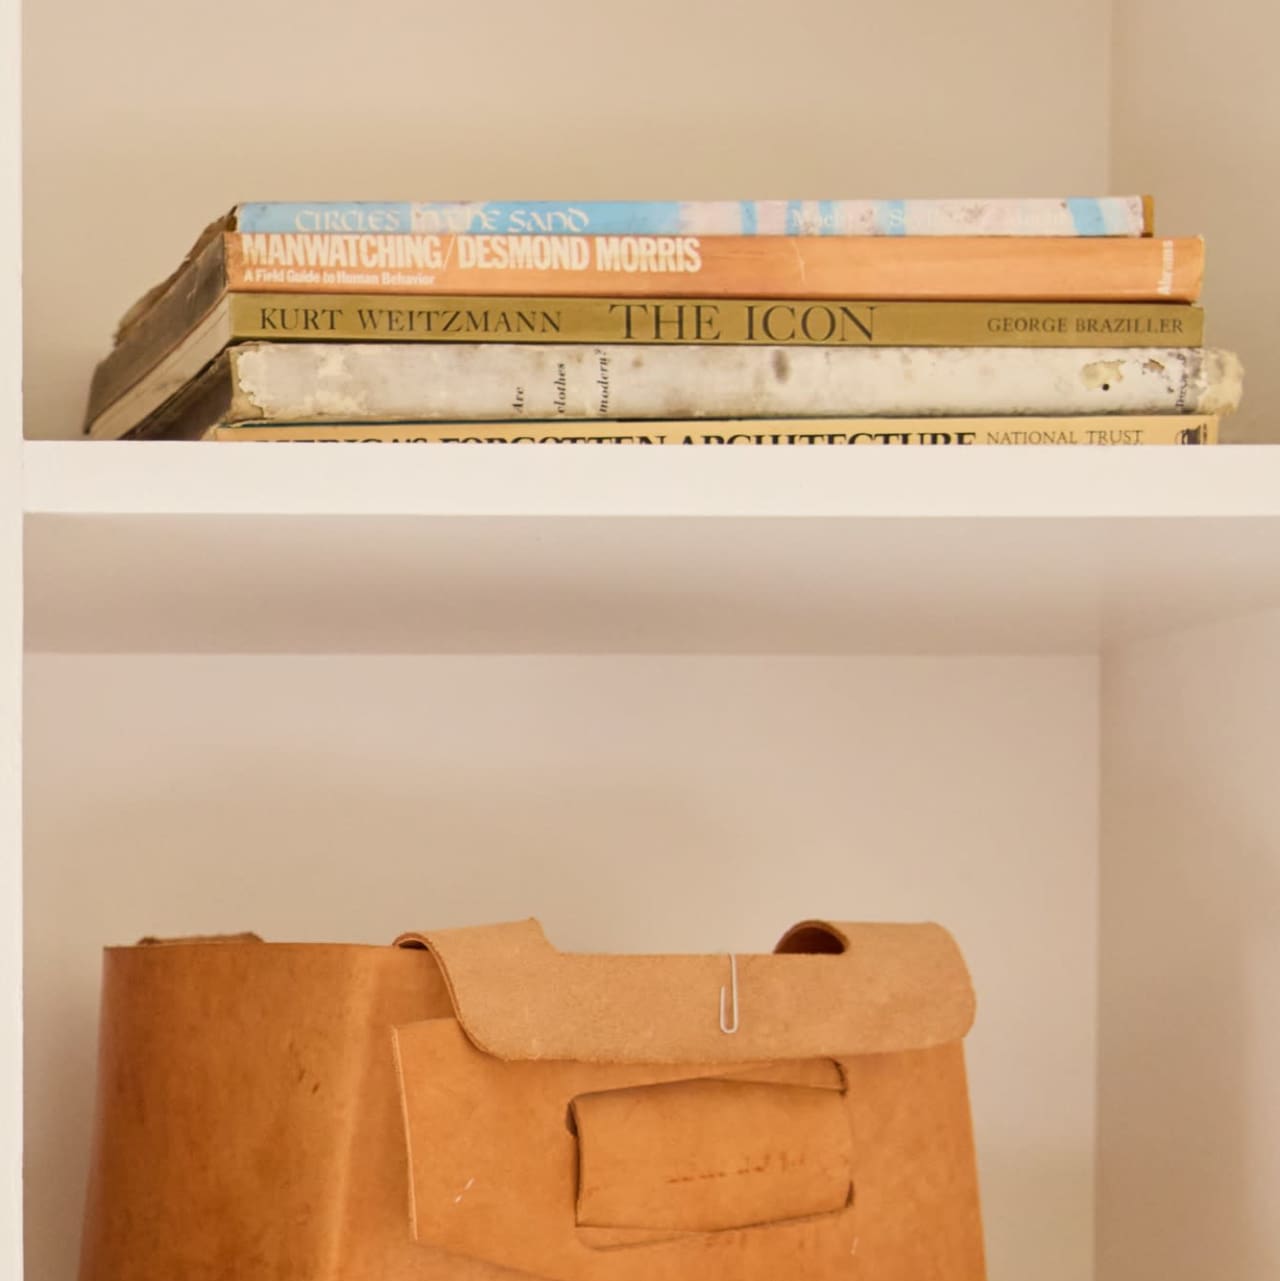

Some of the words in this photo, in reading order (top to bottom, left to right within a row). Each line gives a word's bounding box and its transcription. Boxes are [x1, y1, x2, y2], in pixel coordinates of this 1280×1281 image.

[295, 210, 401, 231] CIRCLES
[596, 236, 703, 272] MORRIS
[244, 269, 253, 282] A
[255, 269, 284, 283] Field
[287, 270, 321, 283] Guide
[323, 272, 335, 284] to
[337, 271, 379, 285] Human
[381, 271, 436, 286] Behavior
[260, 307, 343, 330] KURT
[358, 309, 562, 334] WEITZMANN
[609, 303, 721, 340] THE
[746, 304, 878, 342] ICON
[987, 318, 1068, 334] GEORGE
[1075, 319, 1184, 334] BRAZILLER
[511, 386, 524, 414] Are
[553, 362, 567, 414] clothes
[986, 431, 1078, 444] NATIONAL
[1085, 430, 1144, 444] TRUST
